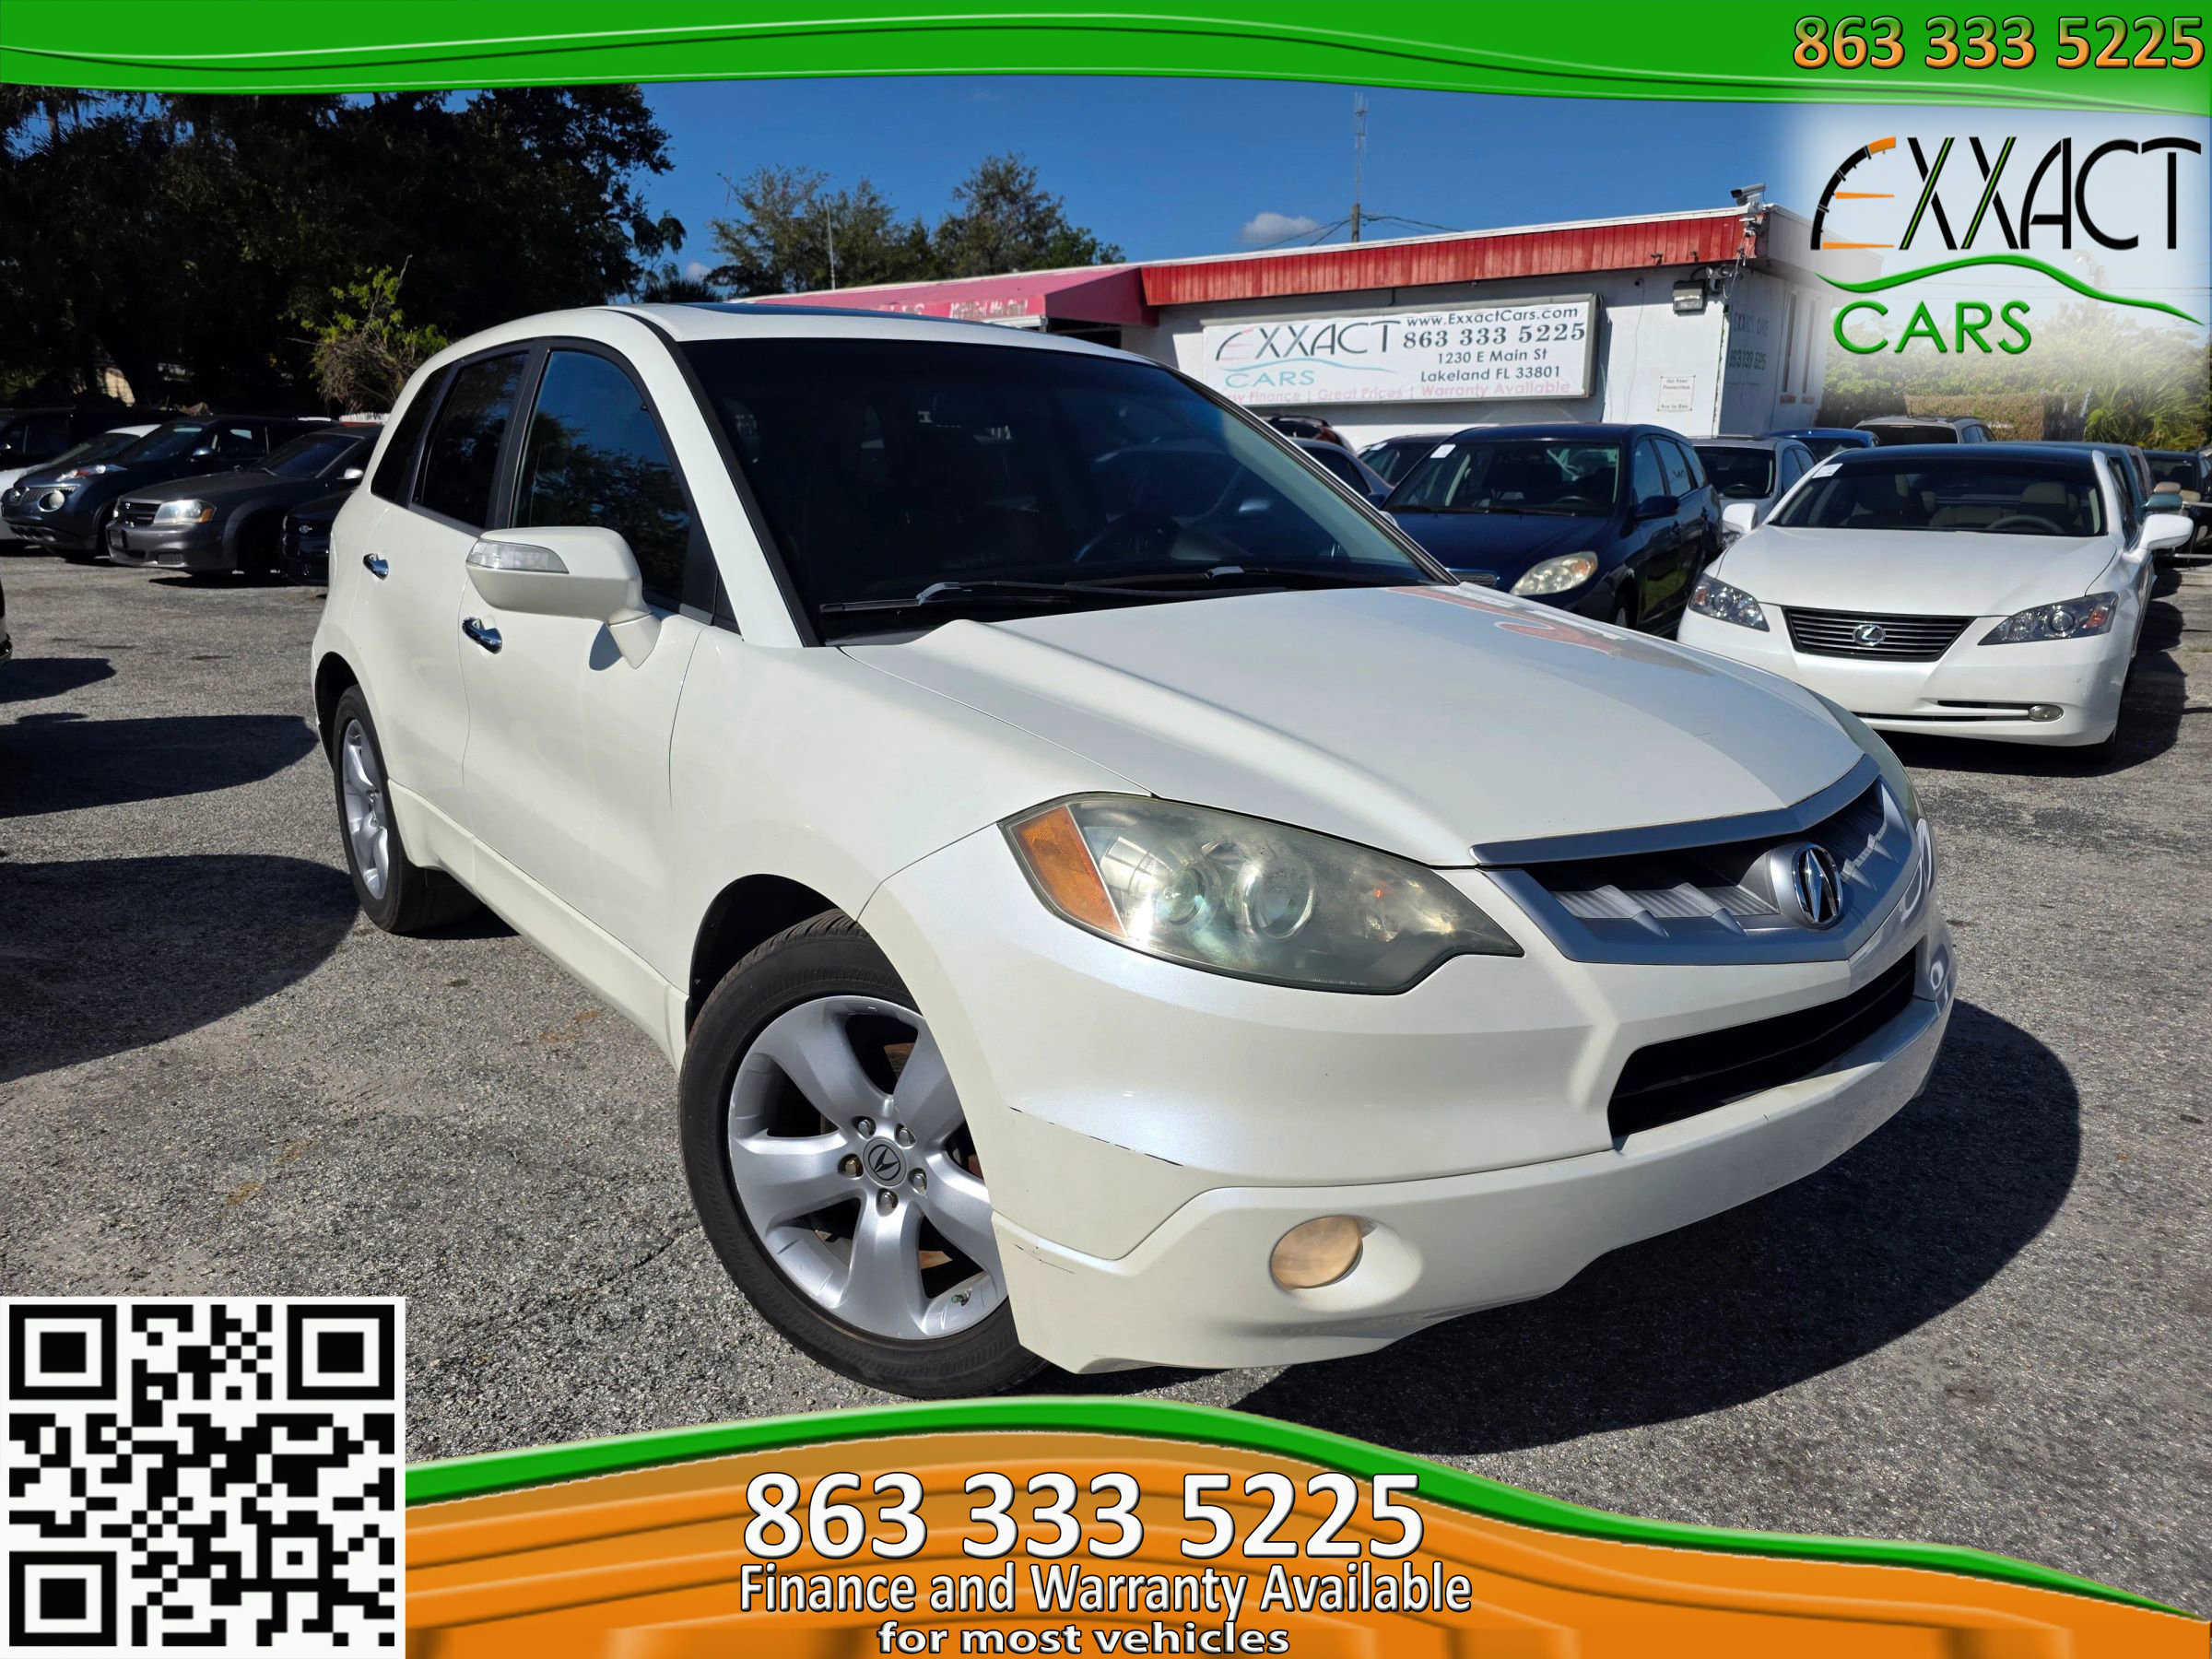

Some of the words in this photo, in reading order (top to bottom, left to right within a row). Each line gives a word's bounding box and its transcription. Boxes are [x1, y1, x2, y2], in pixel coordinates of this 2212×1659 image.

[1406, 308, 1578, 327] www.ExxactCars.com
[1216, 320, 1401, 361] EXXACT
[1403, 330, 1448, 349] 863
[1460, 327, 1507, 346] 333
[1518, 323, 1585, 343] 5225
[1438, 352, 1471, 364] 1230
[1477, 351, 1485, 362] E
[1489, 349, 1527, 361] Main
[1534, 348, 1547, 359] St
[1225, 370, 1315, 388] CARS
[1421, 368, 1490, 382] Lakeland
[1496, 368, 1510, 380] FL
[1515, 366, 1560, 379] 33801
[1249, 389, 1300, 403] Finance
[1318, 389, 1357, 401] Great
[1361, 386, 1403, 399] Prices
[1421, 384, 1488, 398] Warranty
[1494, 381, 1571, 394] Available
